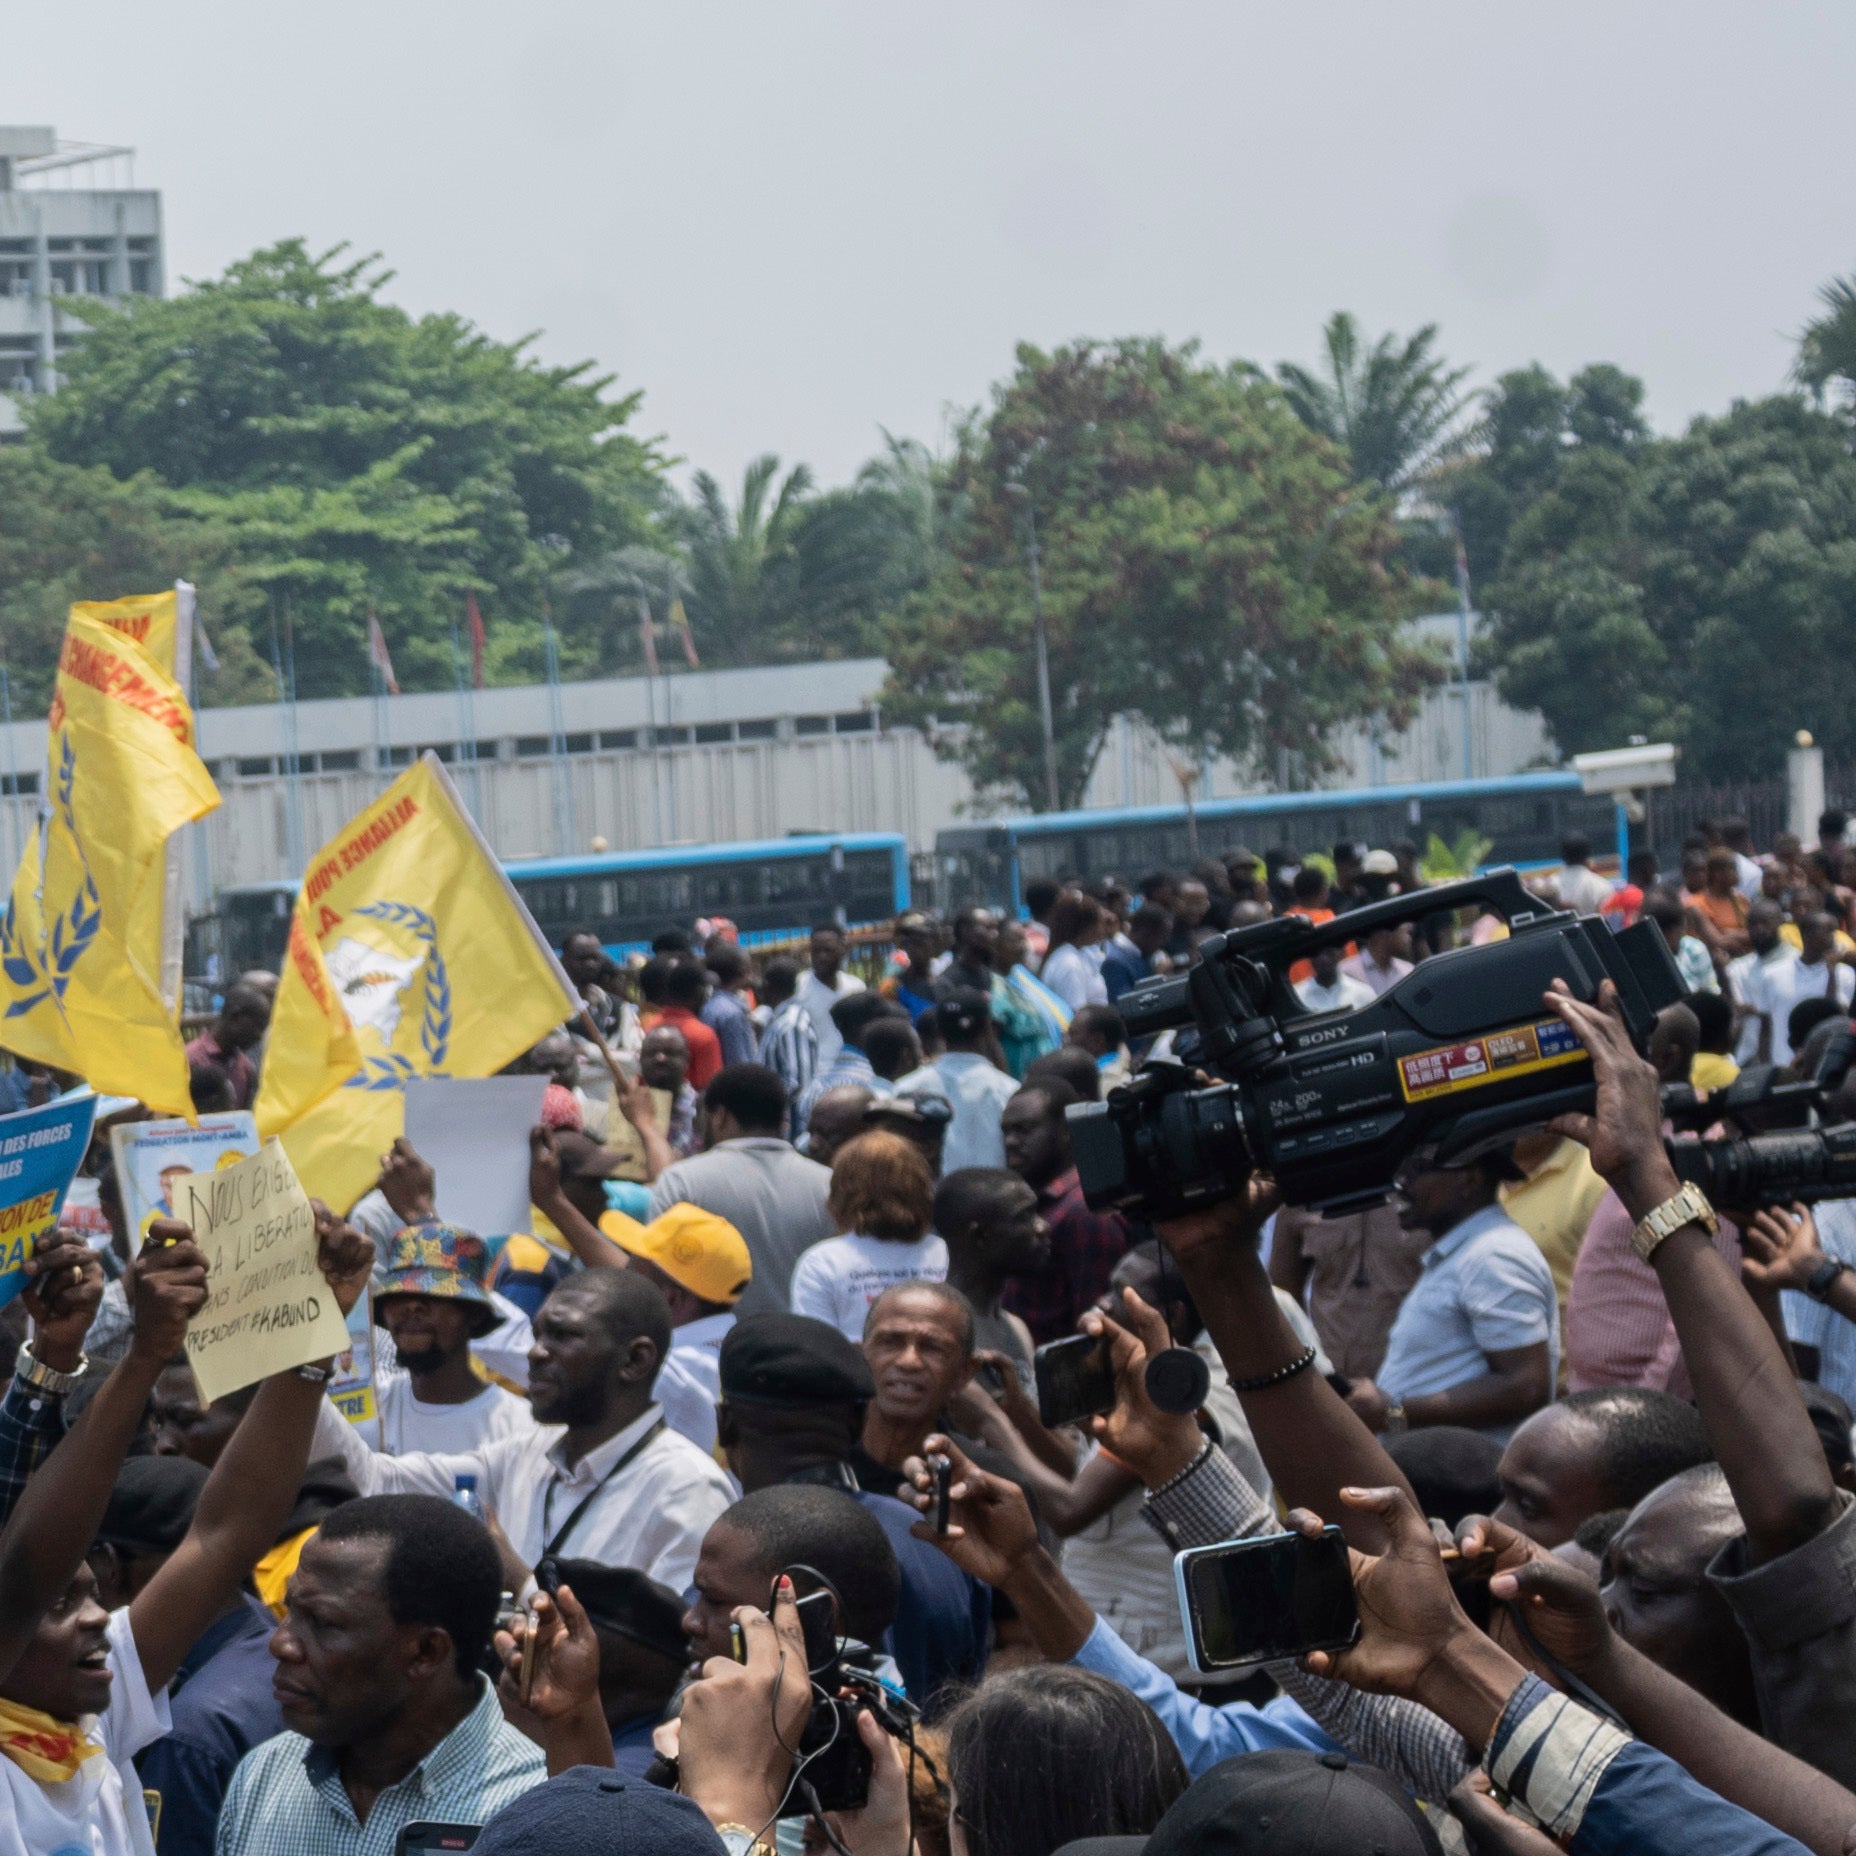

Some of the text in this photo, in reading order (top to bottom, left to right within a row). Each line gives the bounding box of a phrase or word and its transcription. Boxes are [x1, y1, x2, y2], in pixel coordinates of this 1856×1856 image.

[1298, 1025, 1350, 1048] SONY
[1351, 1051, 1375, 1068] HD
[3, 1134, 28, 1156] DES
[28, 1123, 73, 1149] FORCES
[25, 1195, 54, 1228] DE
